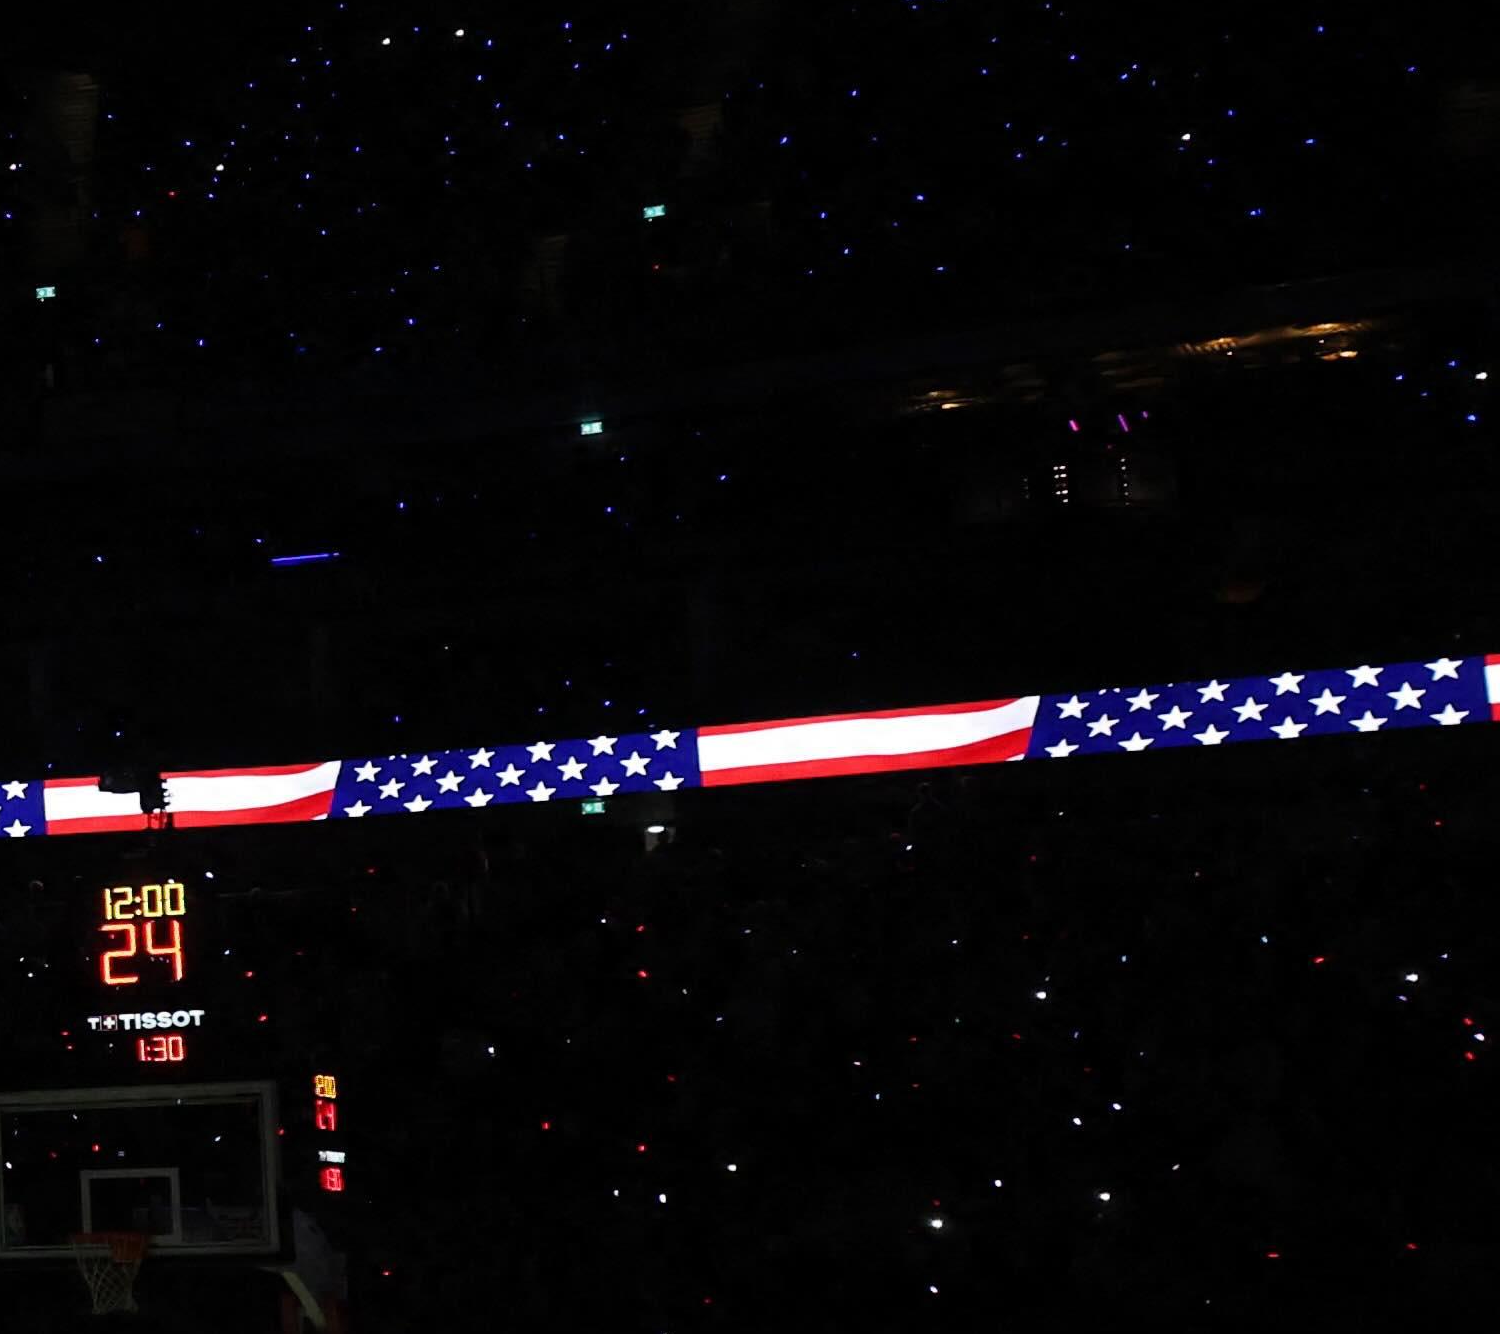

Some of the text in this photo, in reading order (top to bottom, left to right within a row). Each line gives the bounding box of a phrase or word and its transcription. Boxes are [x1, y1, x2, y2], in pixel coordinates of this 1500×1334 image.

[104, 883, 186, 920] 12:00
[100, 920, 184, 985] 24
[119, 1010, 205, 1031] TISSOT
[139, 1036, 185, 1062] 1:30
